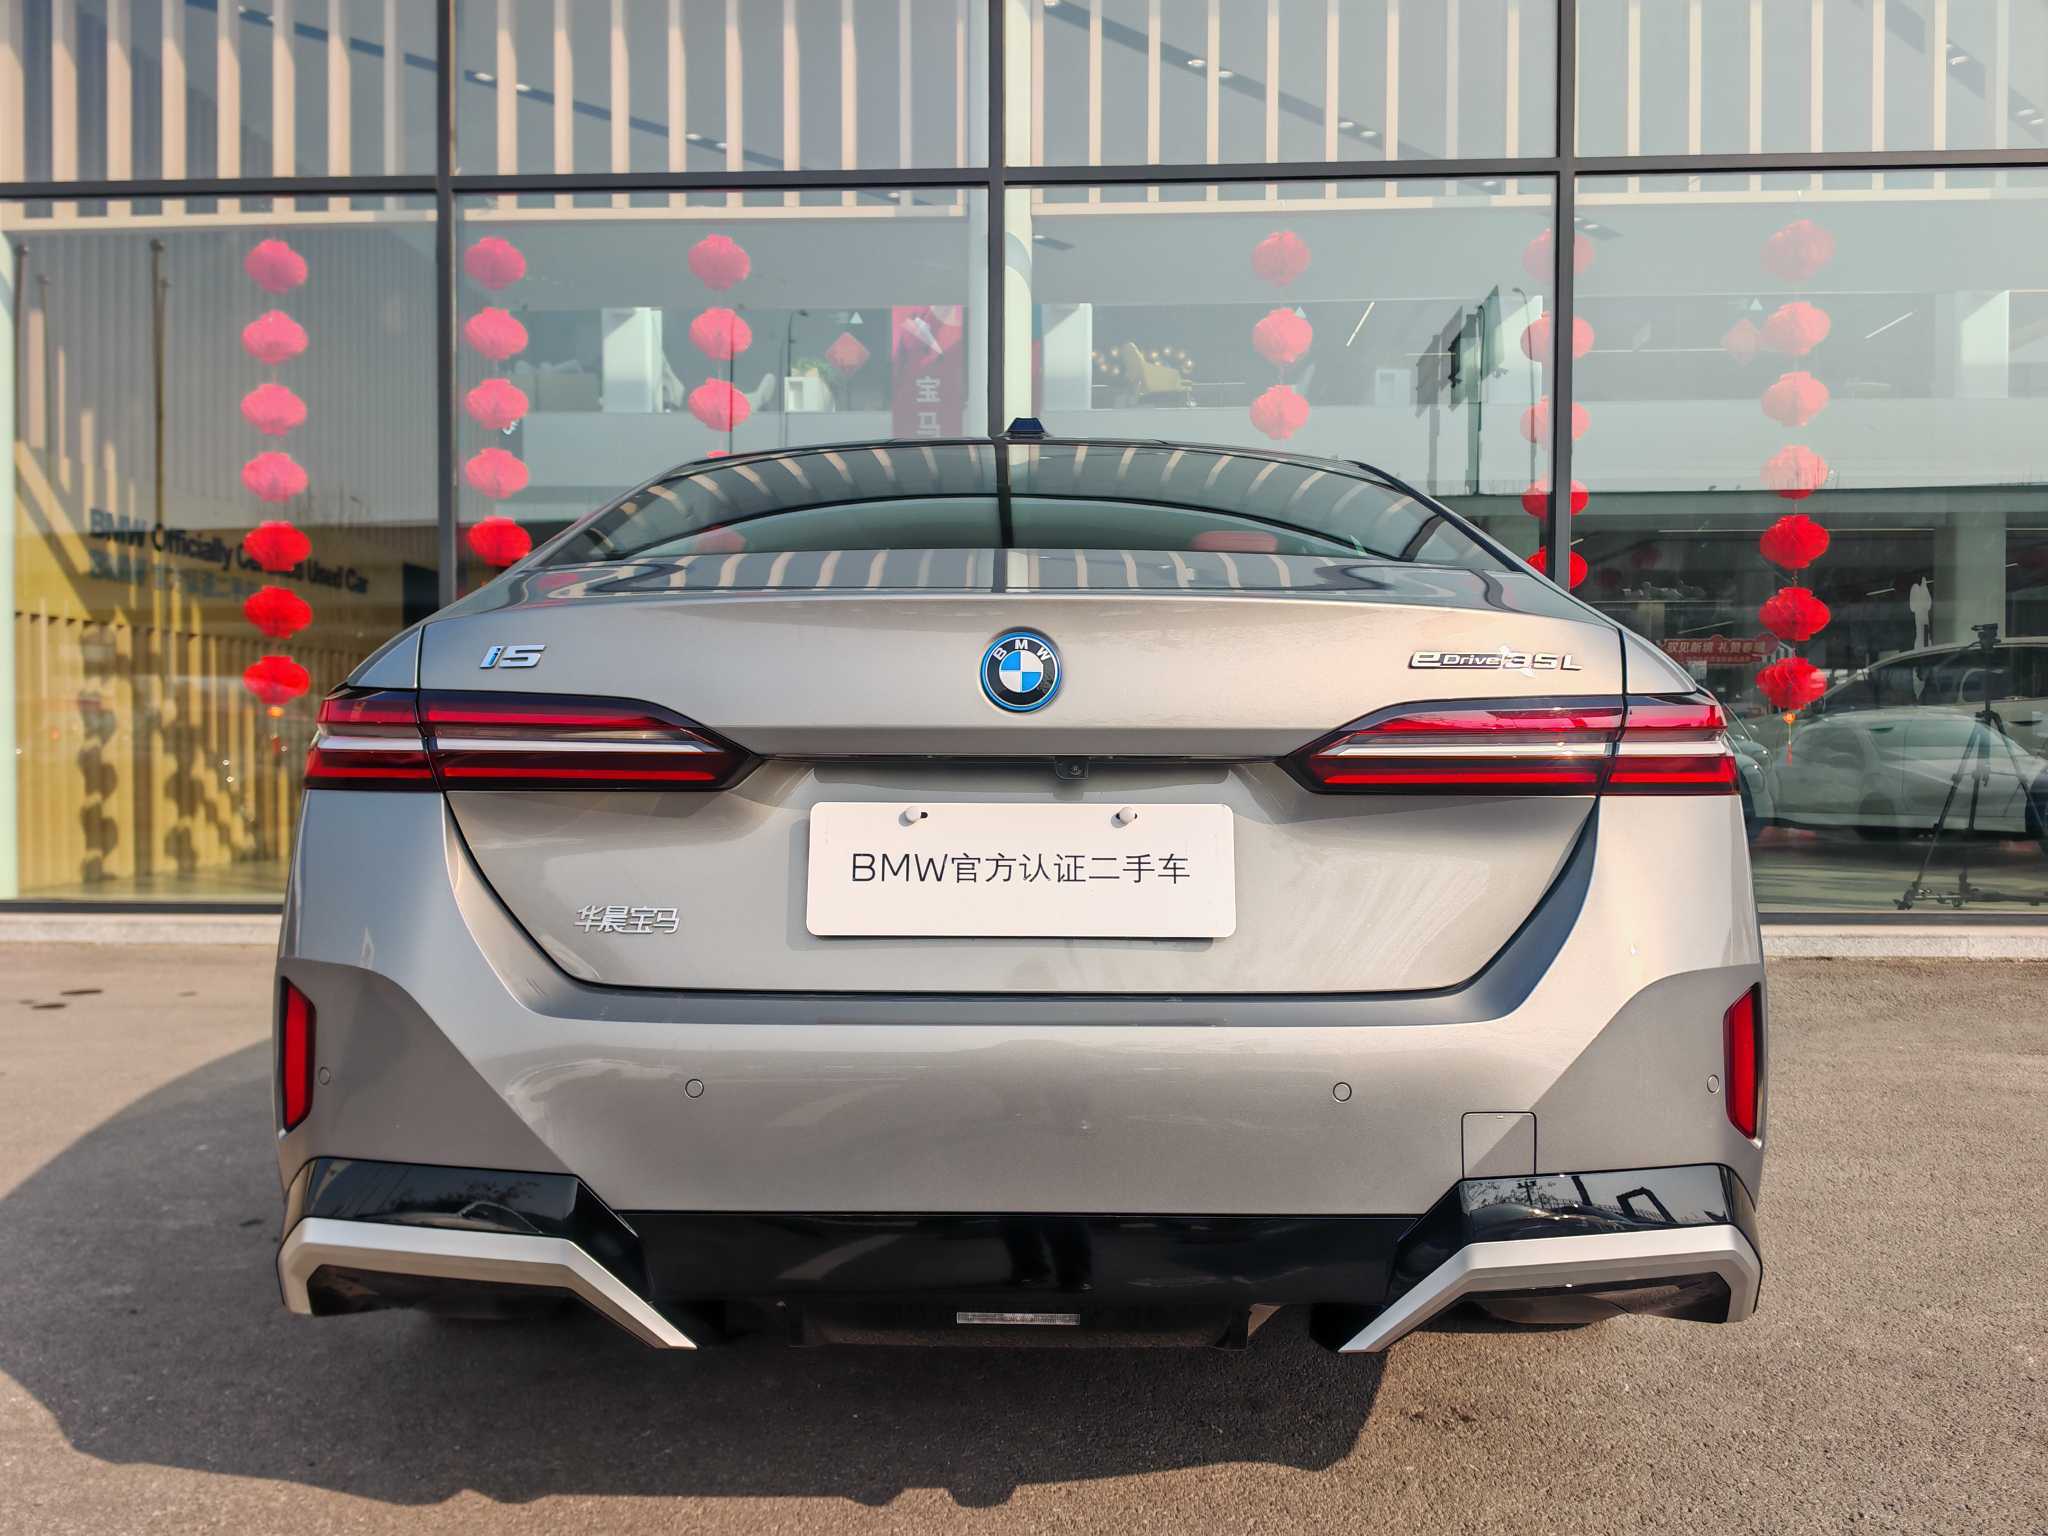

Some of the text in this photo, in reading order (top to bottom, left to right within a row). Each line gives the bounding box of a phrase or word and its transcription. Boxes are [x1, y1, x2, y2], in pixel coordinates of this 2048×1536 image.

[479, 644, 546, 669] i5
[992, 639, 1051, 661] BMW
[850, 851, 1191, 885] BMW官方认证二手车
[574, 904, 680, 935] 华晨宝马
